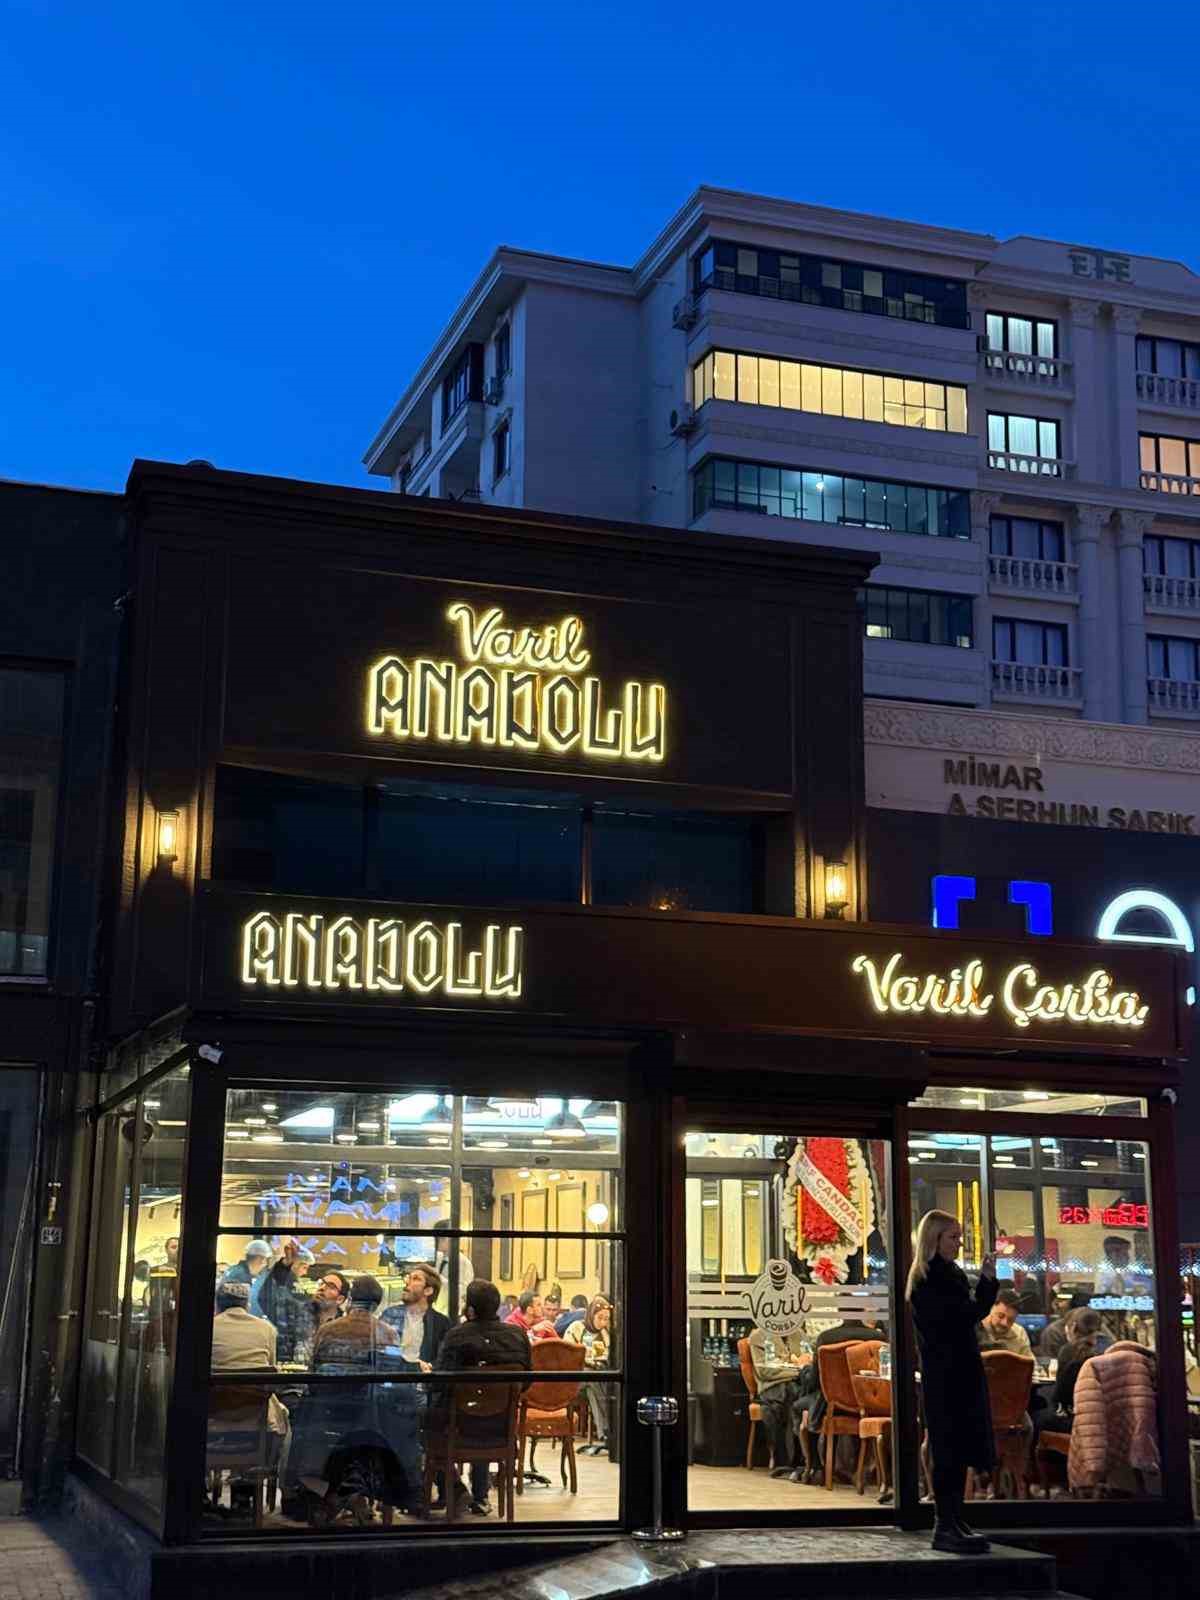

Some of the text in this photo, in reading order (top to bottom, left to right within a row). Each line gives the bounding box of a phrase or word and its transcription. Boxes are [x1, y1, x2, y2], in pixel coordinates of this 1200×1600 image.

[448, 603, 591, 671] Varil
[369, 656, 664, 760] ANADOLU
[945, 753, 1045, 792] MİMAR
[242, 911, 525, 997] ANADOLU
[852, 953, 994, 1016] Varil
[742, 1286, 812, 1319] Varil
